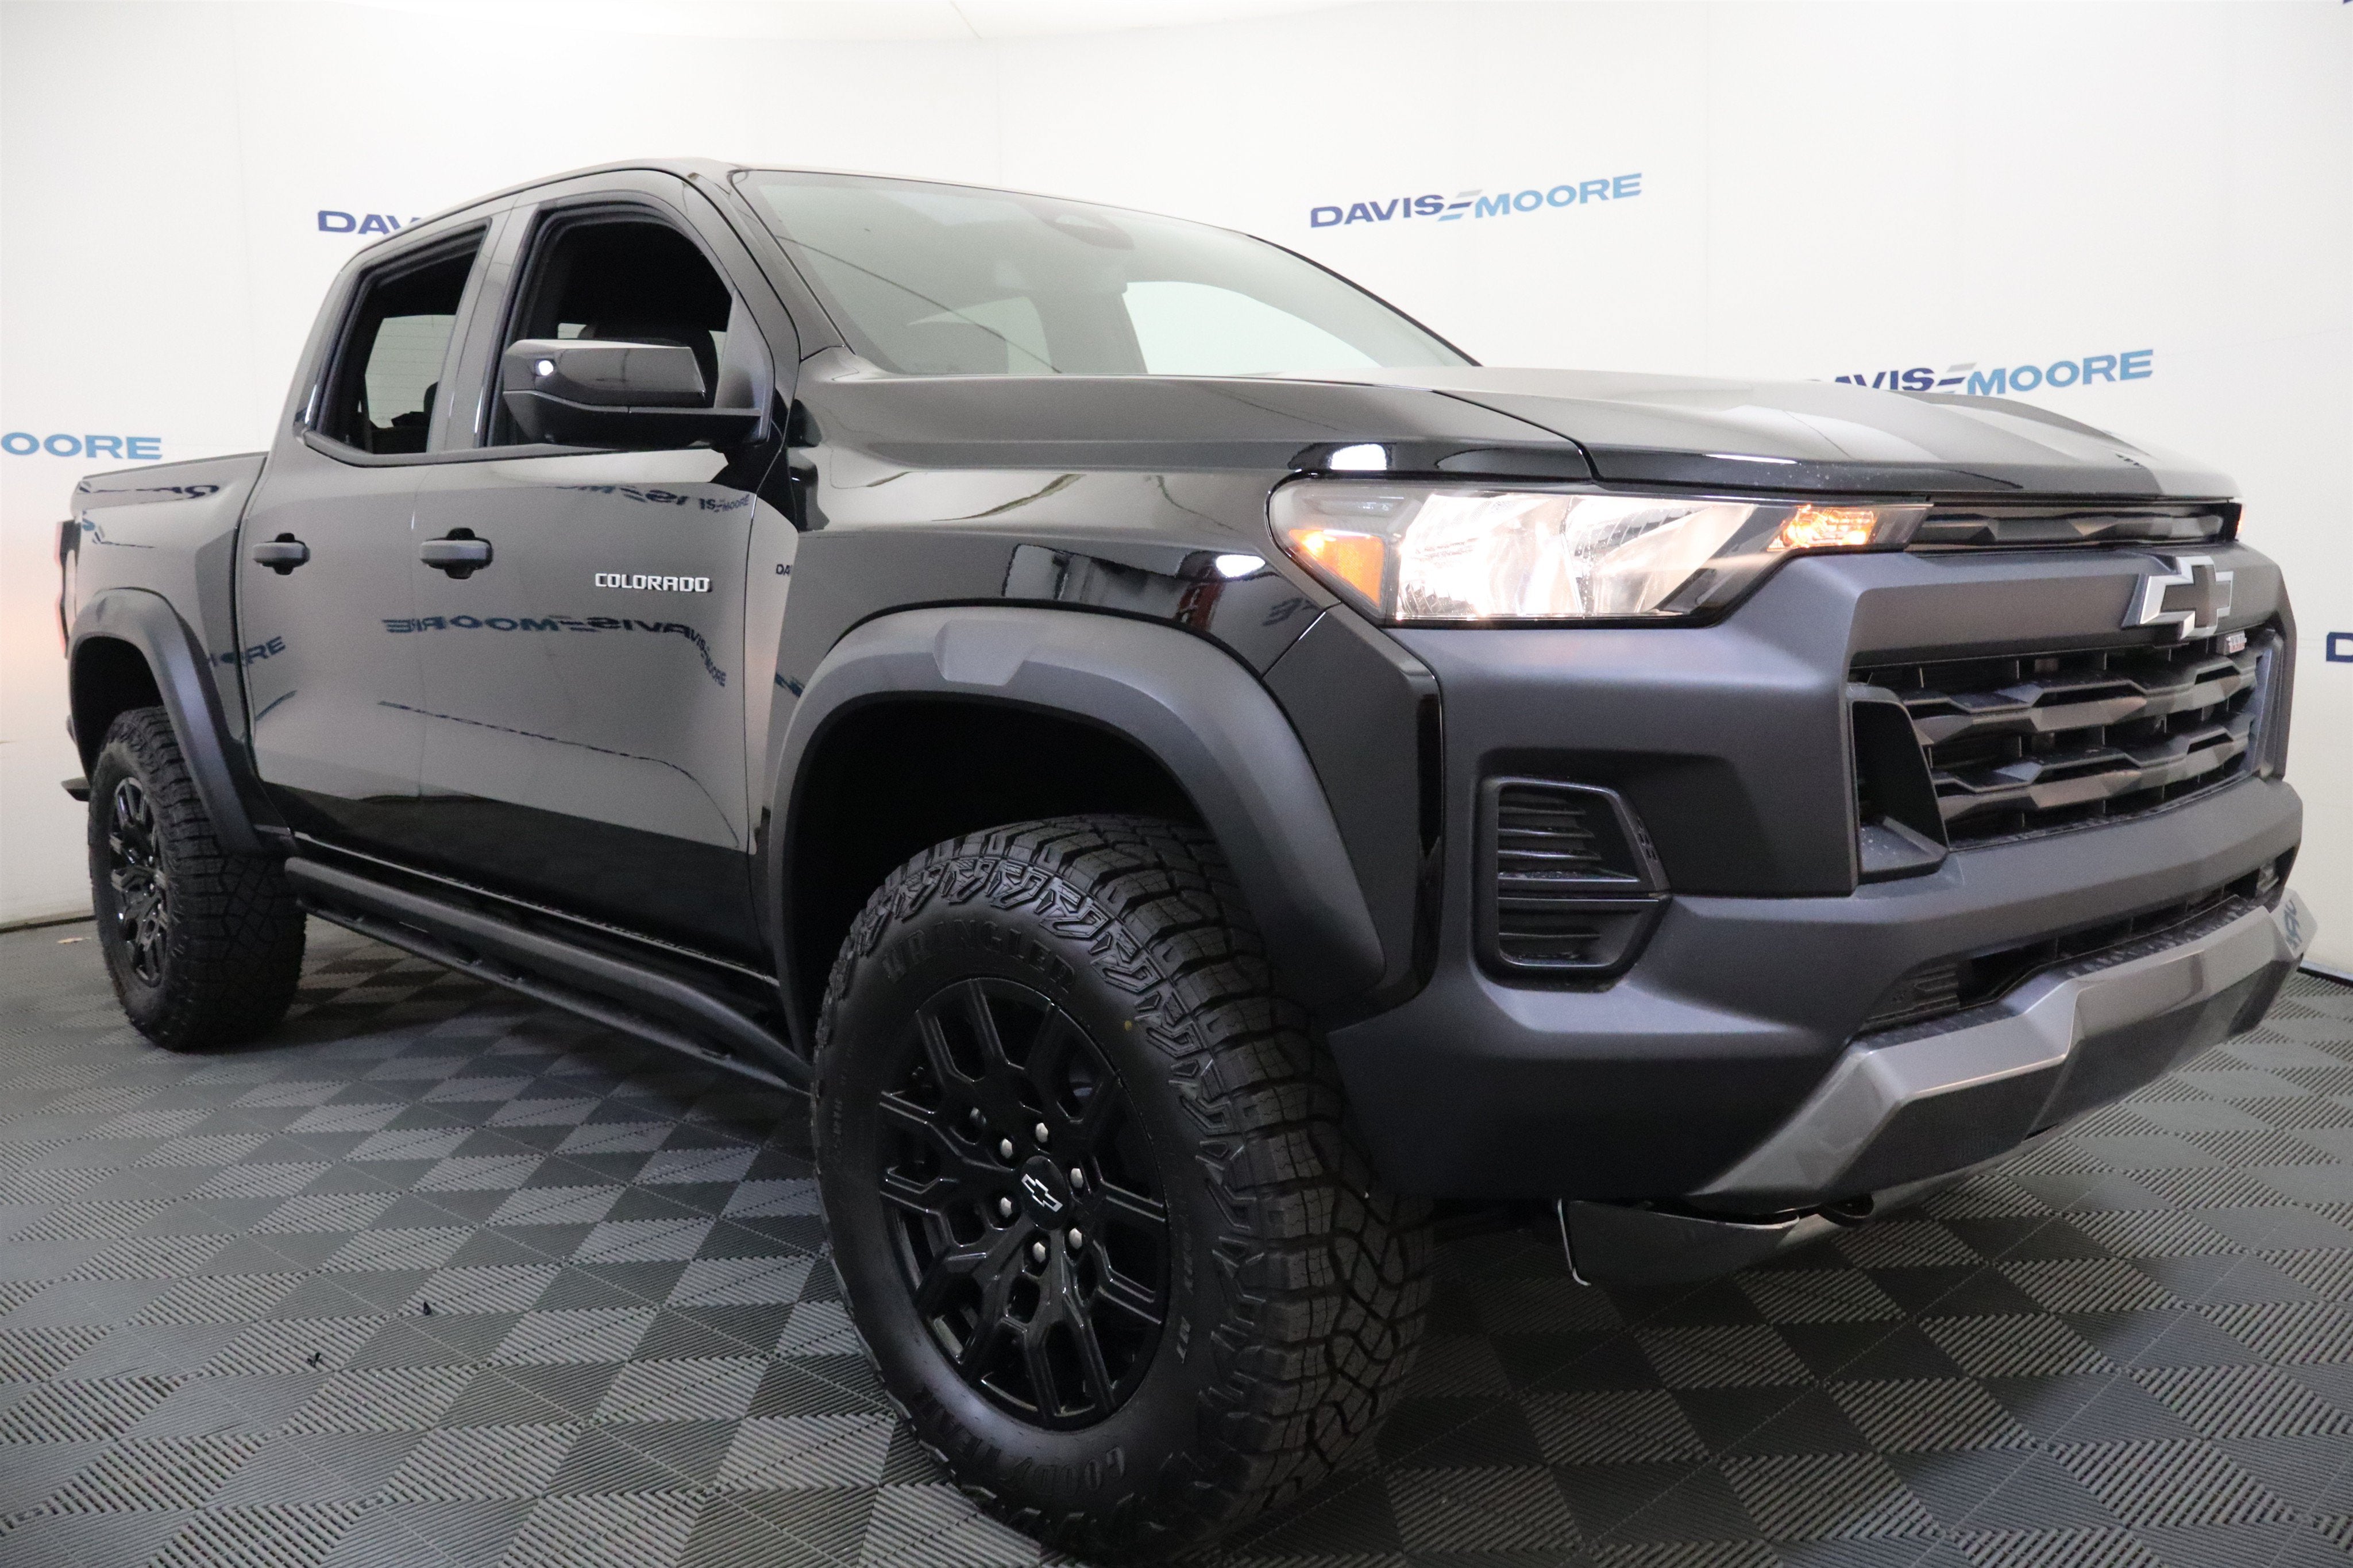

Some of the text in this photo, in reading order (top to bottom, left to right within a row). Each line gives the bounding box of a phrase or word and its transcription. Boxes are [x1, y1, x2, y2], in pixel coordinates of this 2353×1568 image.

[1310, 172, 1642, 229] DAVIS MOORE
[1808, 349, 2154, 396] VIS MOORE
[1, 432, 163, 460] OORE
[595, 573, 711, 593] COLORADO
